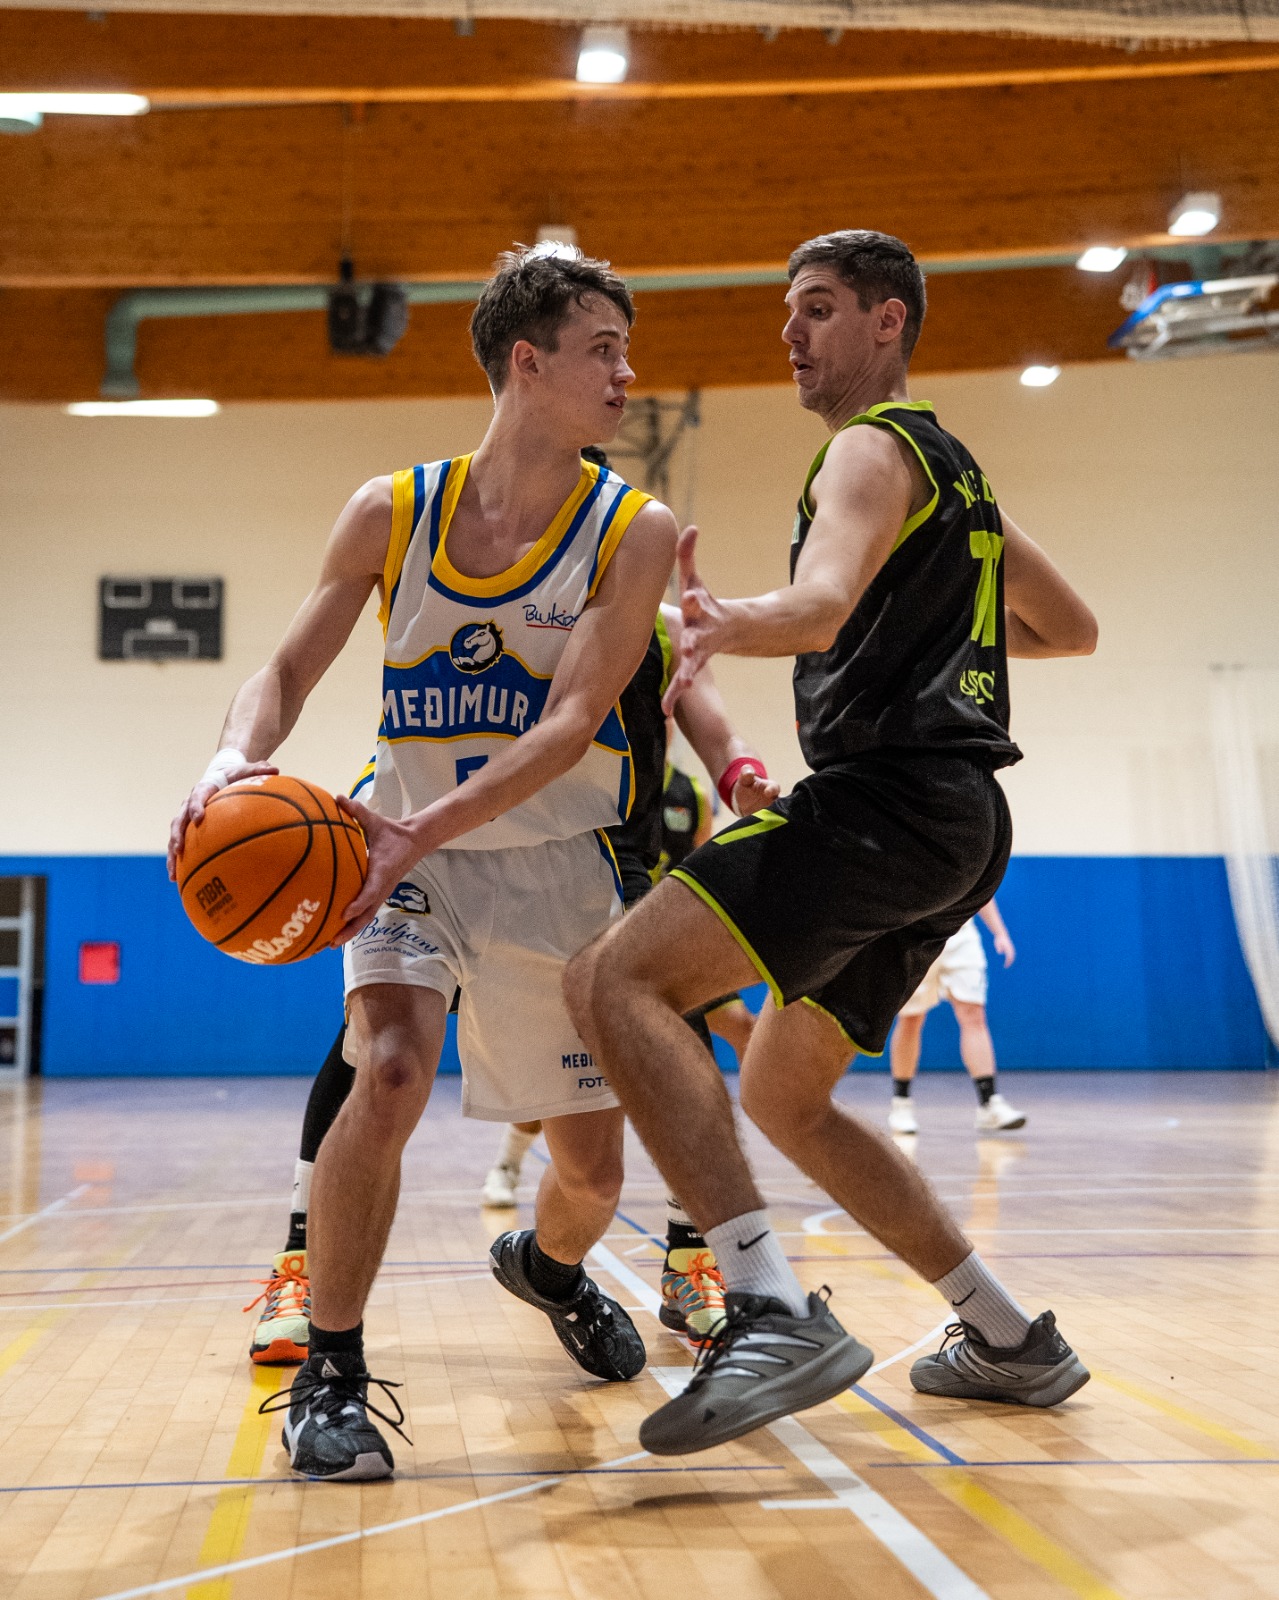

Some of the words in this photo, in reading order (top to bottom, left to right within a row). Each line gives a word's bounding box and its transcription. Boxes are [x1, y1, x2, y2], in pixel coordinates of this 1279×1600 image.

[383, 683, 537, 732] MEĐIMUR
[196, 876, 227, 910] FIBA
[352, 917, 439, 955] Briljant
[562, 1053, 597, 1069] MEĐI
